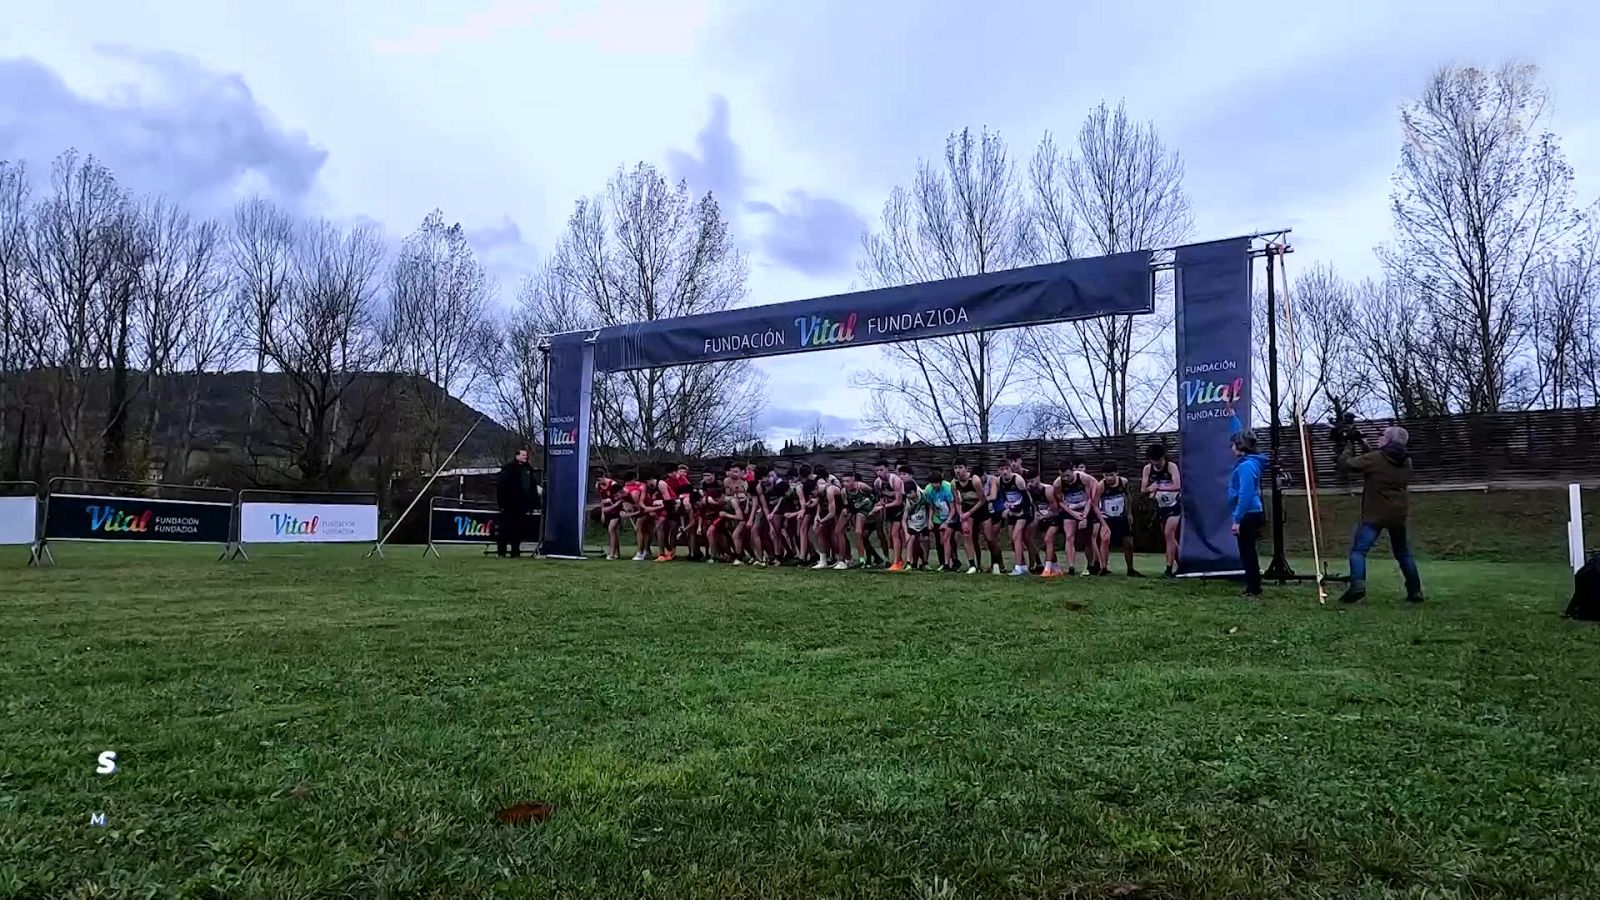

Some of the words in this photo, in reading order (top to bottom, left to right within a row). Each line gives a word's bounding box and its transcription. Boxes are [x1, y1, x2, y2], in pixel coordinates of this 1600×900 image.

[703, 329, 786, 354] FUNDACIÓN
[794, 313, 858, 347] Vital
[867, 307, 968, 335] FUNDAZIOA
[1185, 360, 1236, 375] FUNDACIÓN
[1180, 377, 1243, 406] Vital
[86, 505, 152, 532] Vital
[270, 513, 319, 535] Vital
[454, 516, 493, 536] Vital
